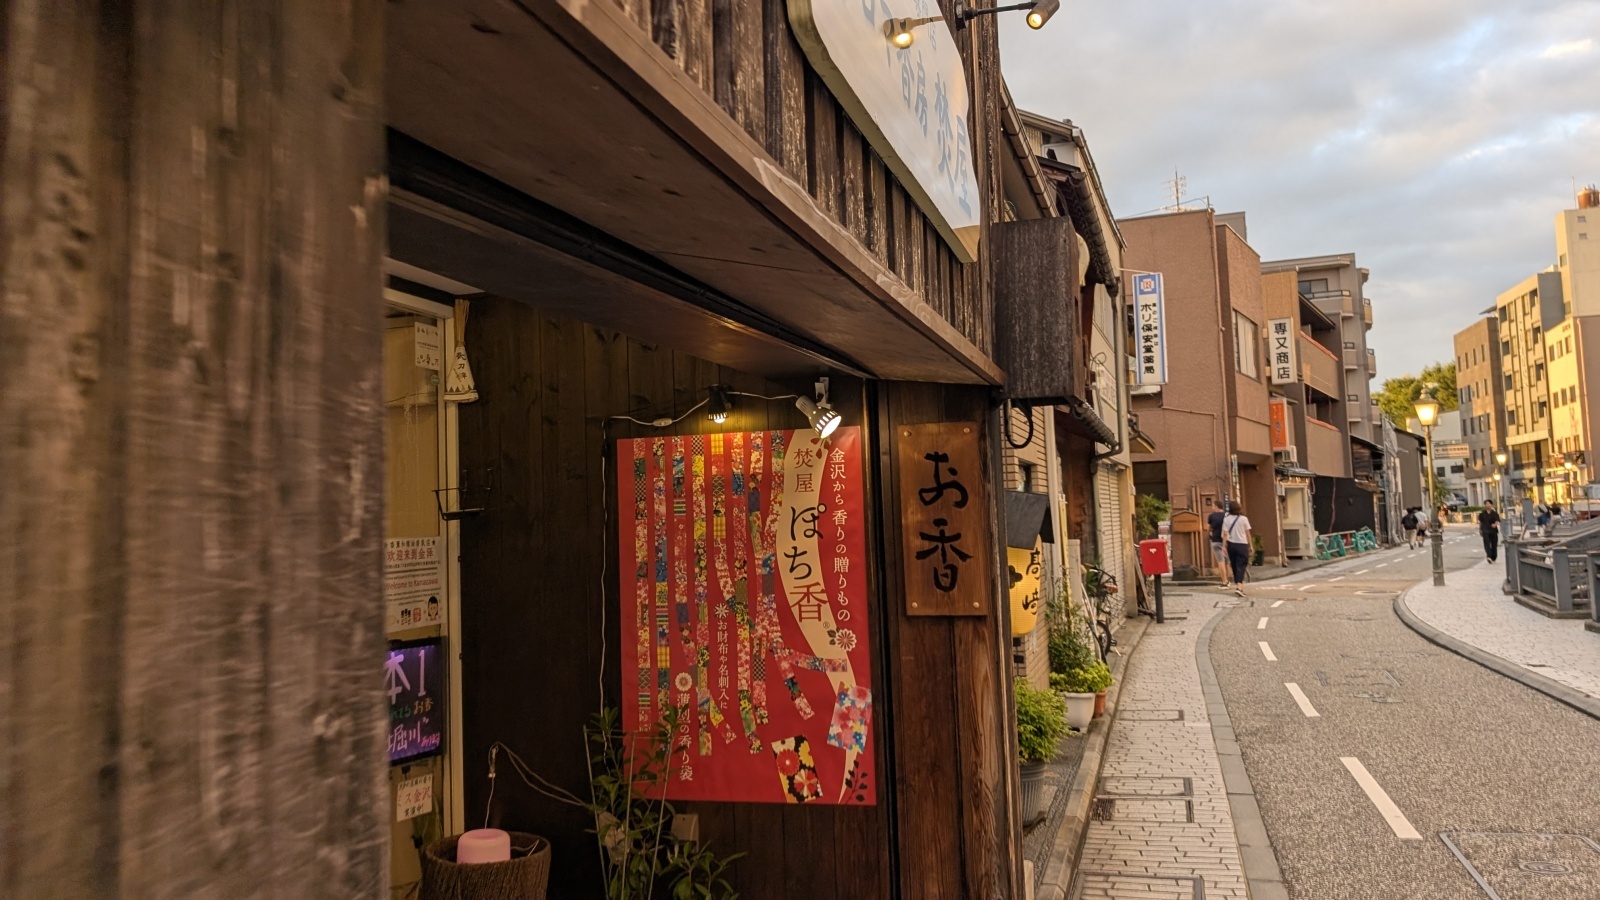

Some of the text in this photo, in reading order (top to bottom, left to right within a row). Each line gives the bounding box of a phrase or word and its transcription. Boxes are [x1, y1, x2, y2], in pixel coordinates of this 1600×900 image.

[1274, 322, 1290, 380] 専又商店
[793, 448, 815, 493] 焚屋
[829, 447, 851, 622] 金沢から香りの贈りもの
[915, 451, 973, 593] お香
